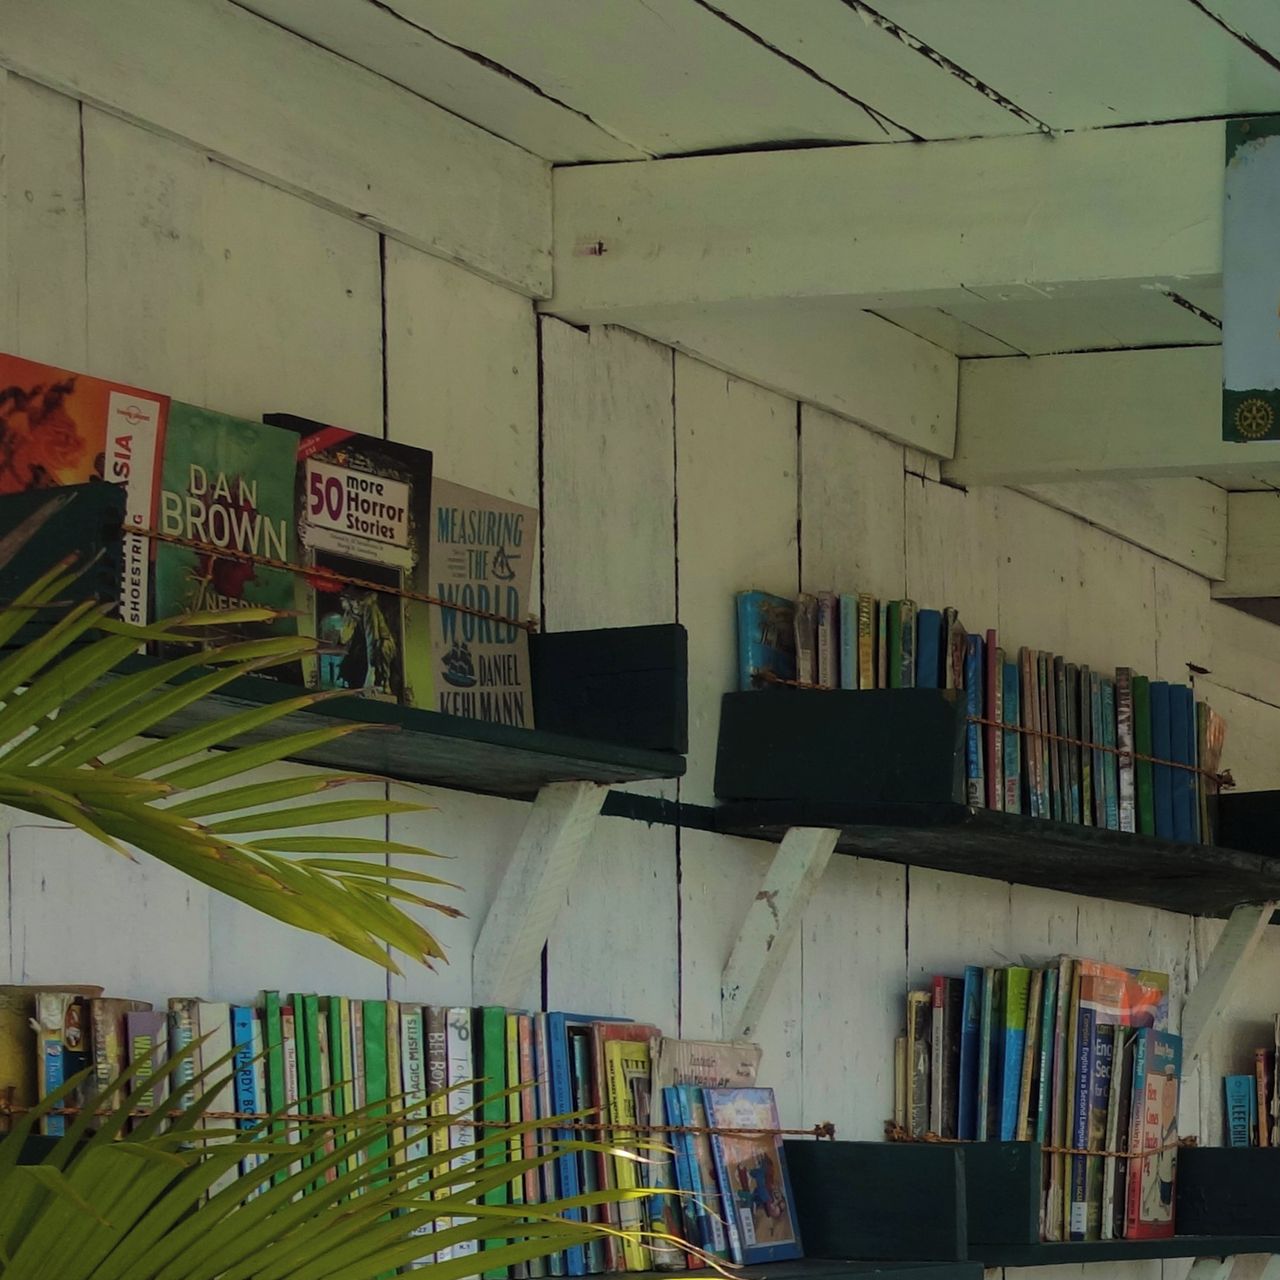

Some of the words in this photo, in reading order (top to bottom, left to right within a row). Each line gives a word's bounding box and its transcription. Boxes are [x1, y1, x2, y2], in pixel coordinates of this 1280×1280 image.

[113, 435, 133, 486] SIA
[190, 463, 258, 510] DAN
[310, 471, 344, 521] 50
[346, 475, 384, 497] more
[346, 490, 405, 523] Horror
[161, 489, 287, 562] BROWN
[346, 513, 396, 540] Stories
[437, 506, 525, 548] MEASURING
[466, 549, 489, 580] THE
[437, 583, 520, 645] WORLD
[478, 653, 522, 687] DANIEL
[440, 690, 524, 722] KEHLMANN
[407, 1019, 419, 1061] MISFITS
[1080, 1013, 1091, 1046] Complete
[240, 1051, 252, 1095] HARDY
[429, 1061, 445, 1089] BOY
[1080, 1047, 1090, 1073] English
[409, 1063, 420, 1100] MAGIC
[1079, 1089, 1089, 1116] Second
[1231, 1105, 1247, 1121] LEE
[1231, 1124, 1247, 1145] CHIL
